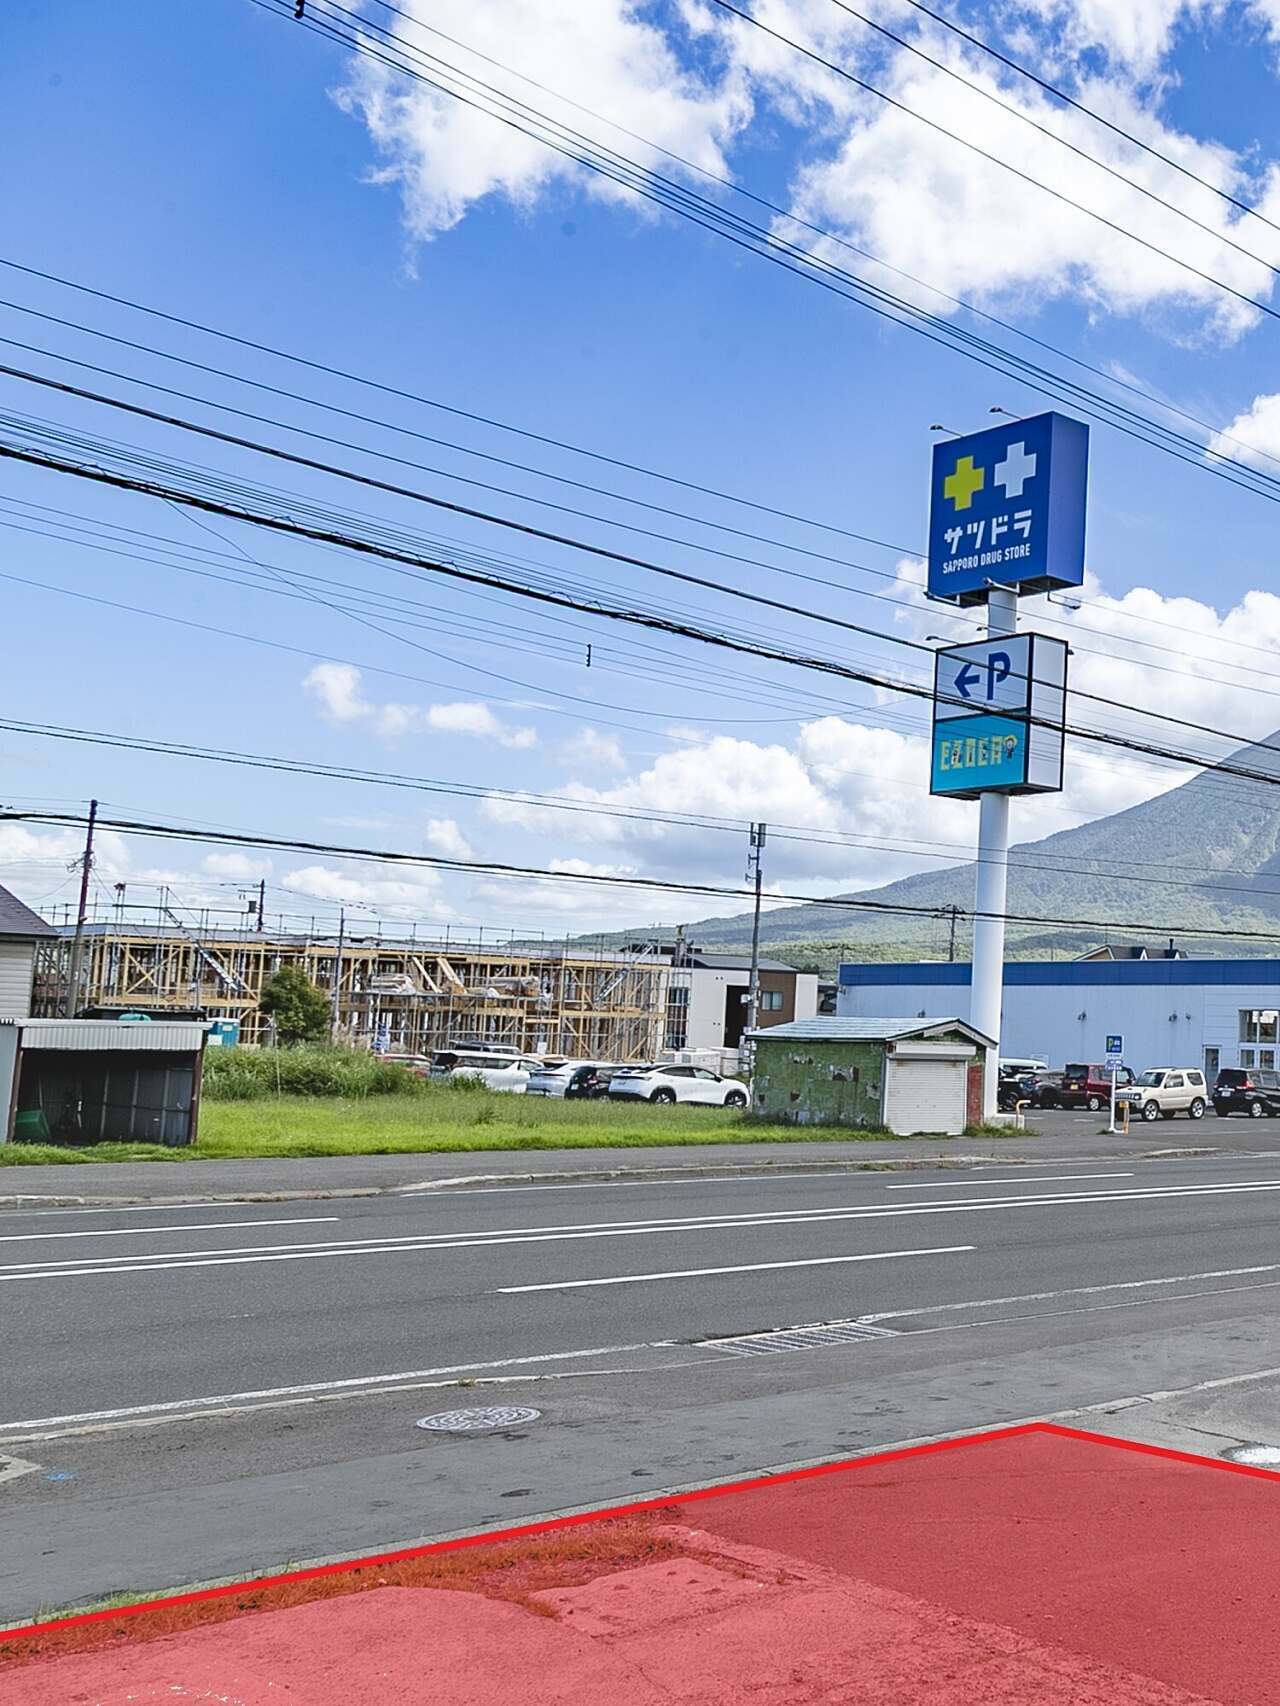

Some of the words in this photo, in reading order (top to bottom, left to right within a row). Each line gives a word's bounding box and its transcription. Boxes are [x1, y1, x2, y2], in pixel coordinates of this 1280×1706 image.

[943, 509, 1032, 555] サツドラ
[942, 556, 979, 574] SAPPORO
[980, 550, 1003, 567] DRUG
[1004, 543, 1031, 560] STORE
[986, 651, 1011, 701] P
